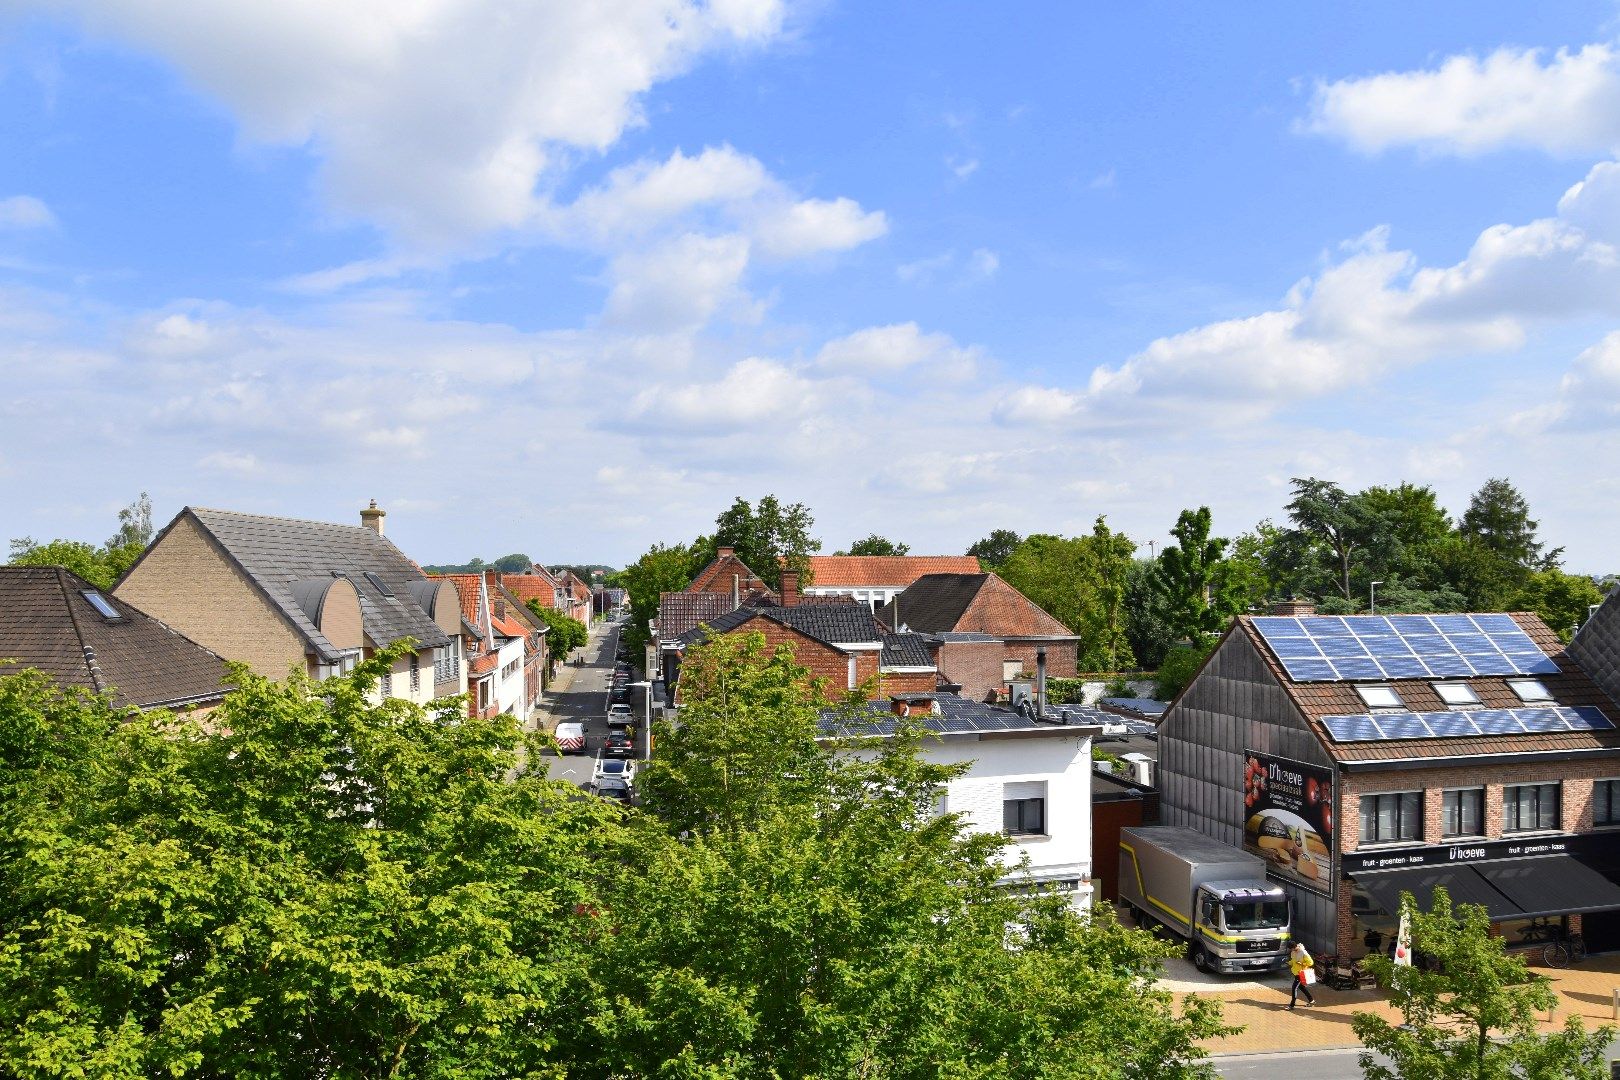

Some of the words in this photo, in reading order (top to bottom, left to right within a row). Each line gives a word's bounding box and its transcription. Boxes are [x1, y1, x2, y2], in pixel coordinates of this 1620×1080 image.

[1508, 846, 1521, 854] fruit
[1524, 845, 1549, 854] groenten
[1362, 859, 1375, 867] fruit
[1379, 857, 1406, 867] groenten
[1409, 855, 1424, 863] kaas
